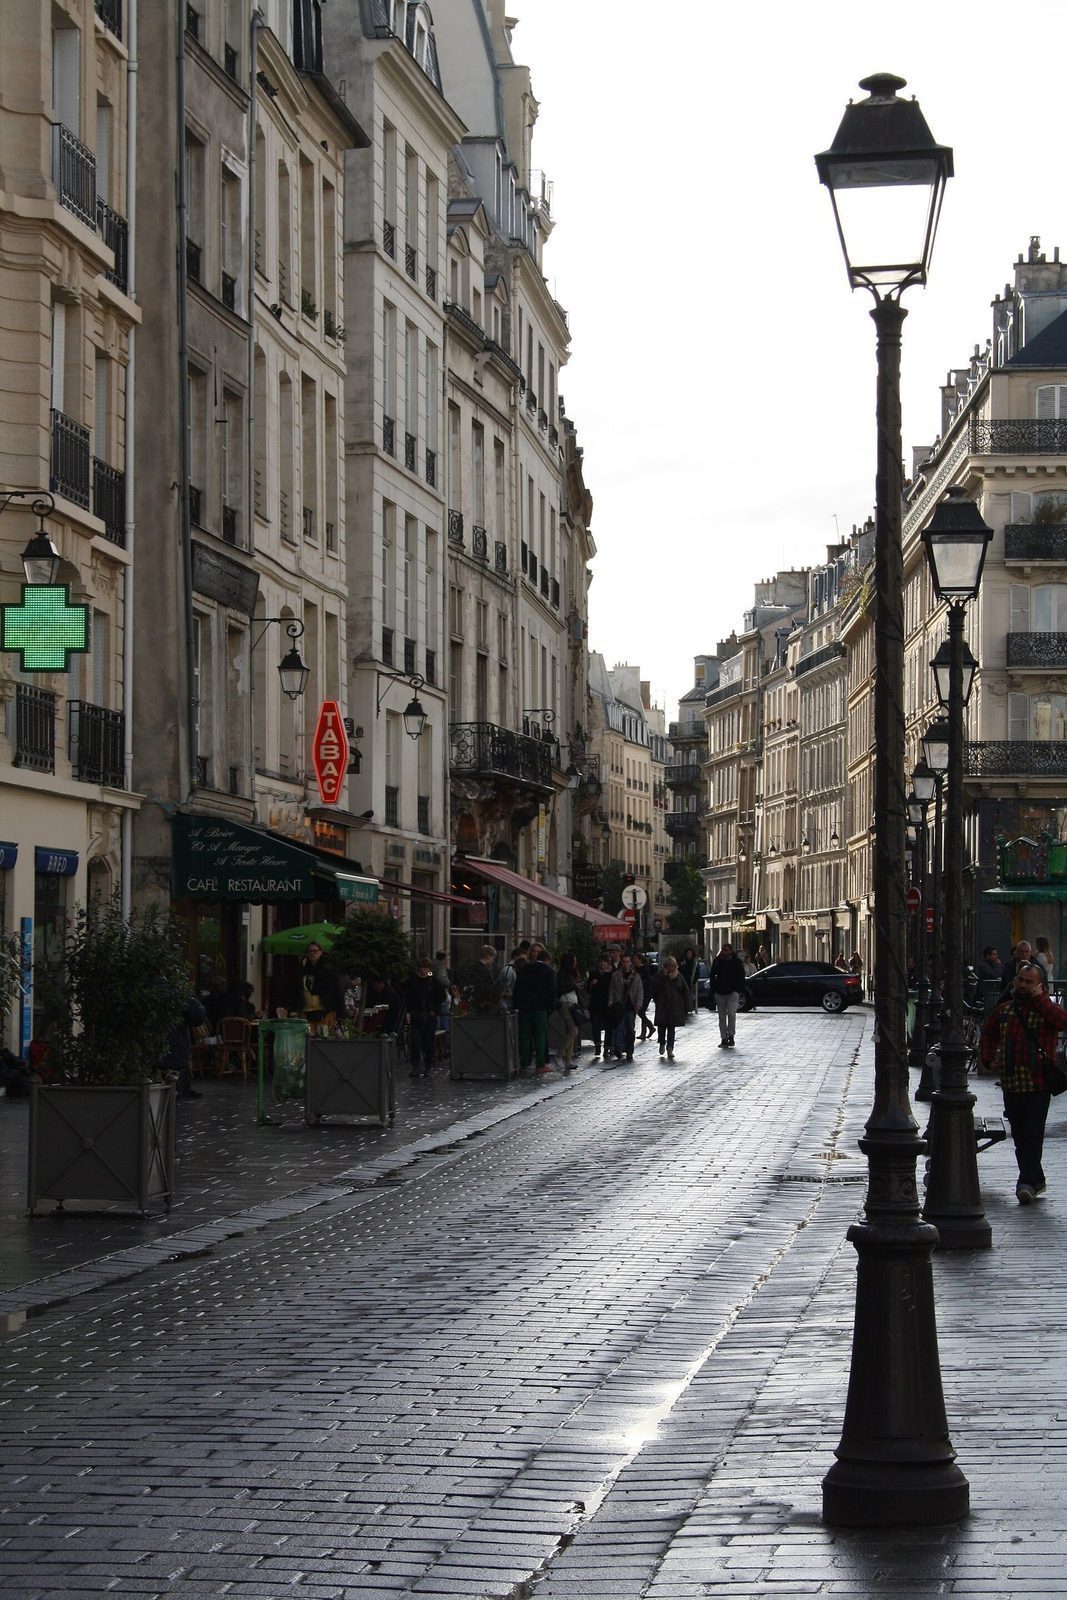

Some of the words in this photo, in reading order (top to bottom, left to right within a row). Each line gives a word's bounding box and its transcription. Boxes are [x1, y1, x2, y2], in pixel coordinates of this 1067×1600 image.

[320, 711, 340, 794] TABAC
[204, 827, 235, 839] Boire
[191, 840, 205, 851] Et
[223, 841, 262, 855] Manger
[47, 855, 67, 872] BRED
[232, 855, 257, 866] Toute
[260, 855, 287, 866] Heure
[228, 879, 303, 892] RESTAURANT
